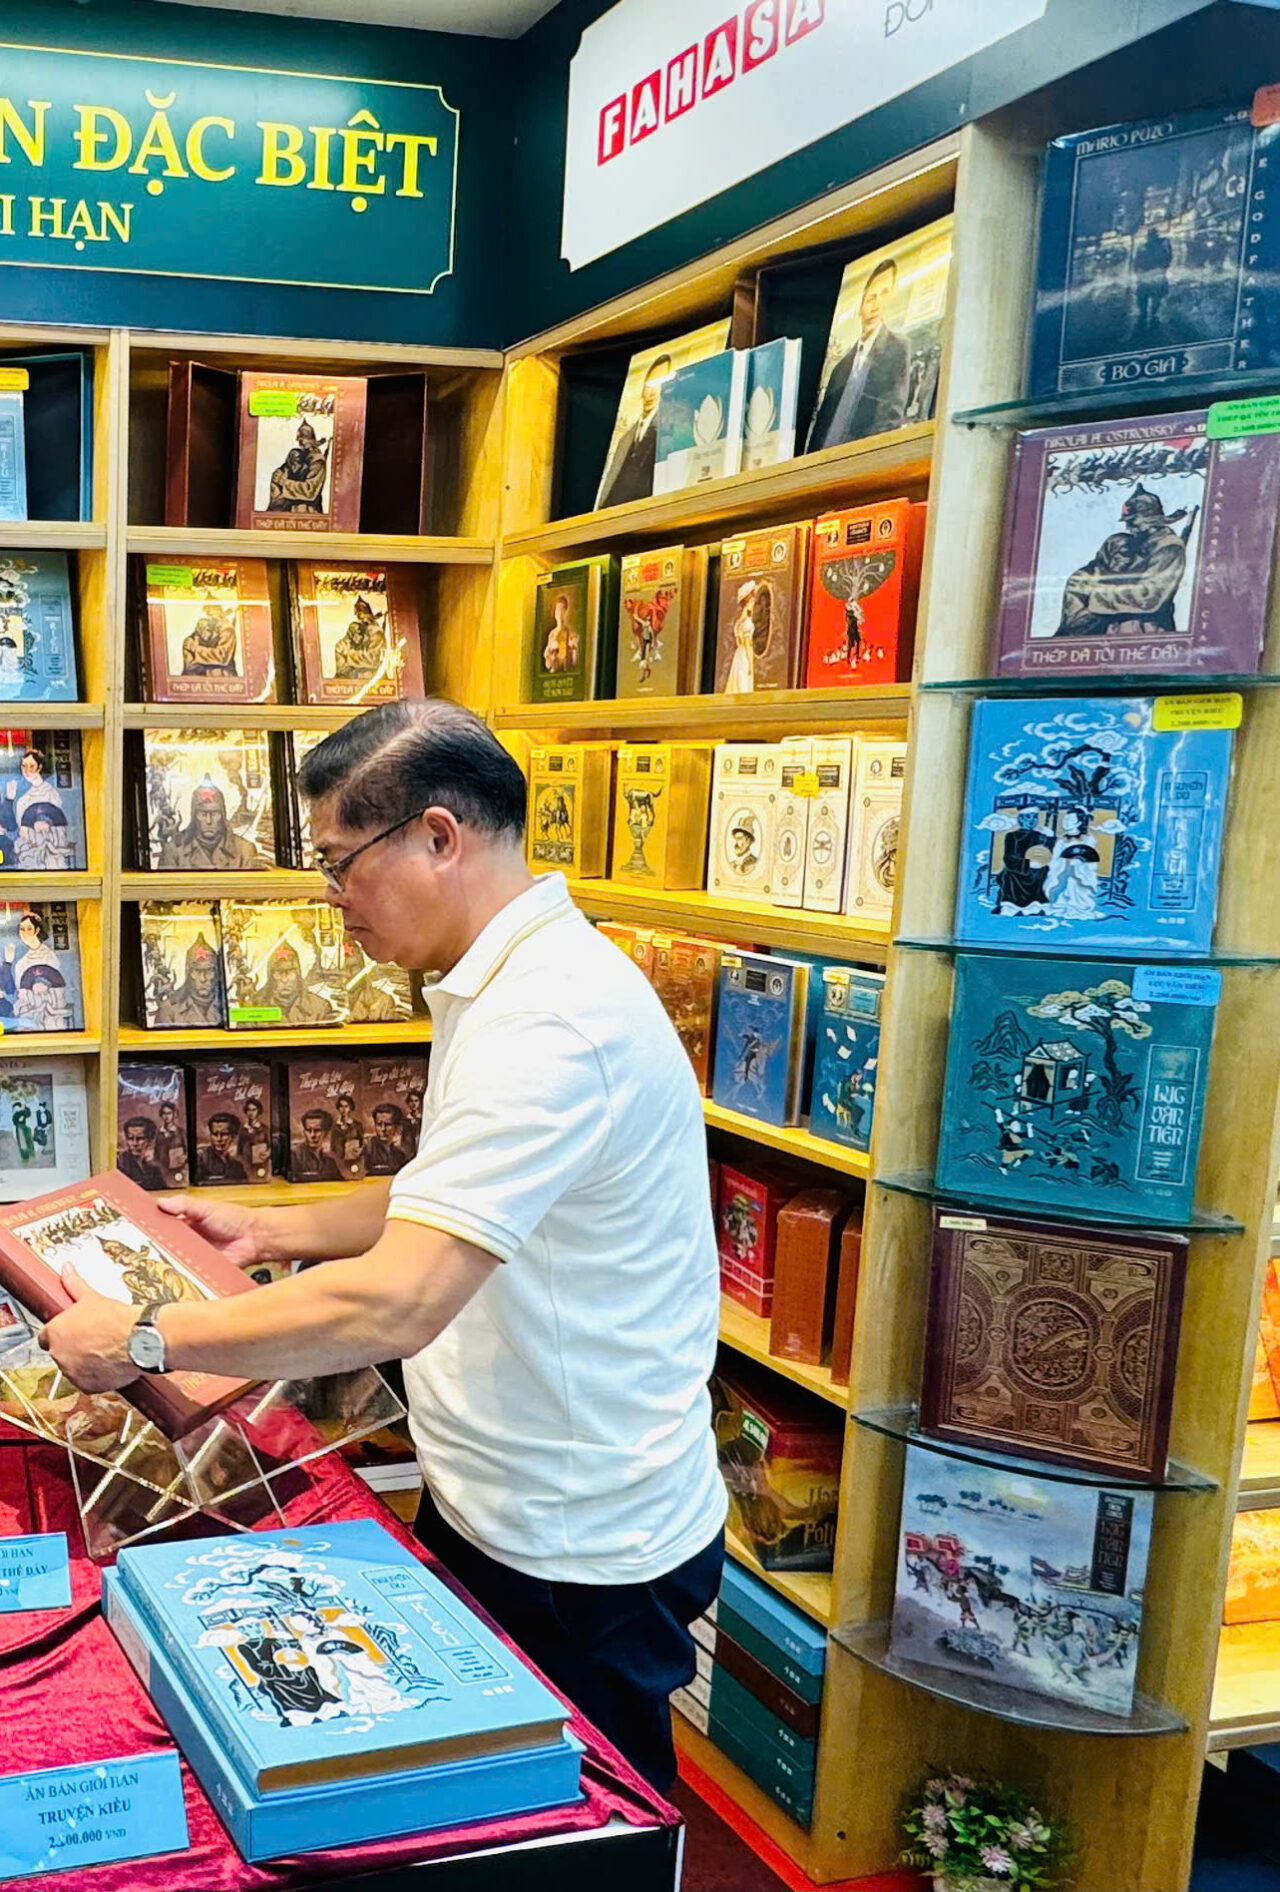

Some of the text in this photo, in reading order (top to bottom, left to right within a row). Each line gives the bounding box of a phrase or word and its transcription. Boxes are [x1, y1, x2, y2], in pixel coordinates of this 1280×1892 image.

[598, 0, 825, 167] FAHASA
[73, 89, 236, 196] ĐẶC
[256, 110, 438, 213] BIỆT
[28, 197, 134, 251] HẠN
